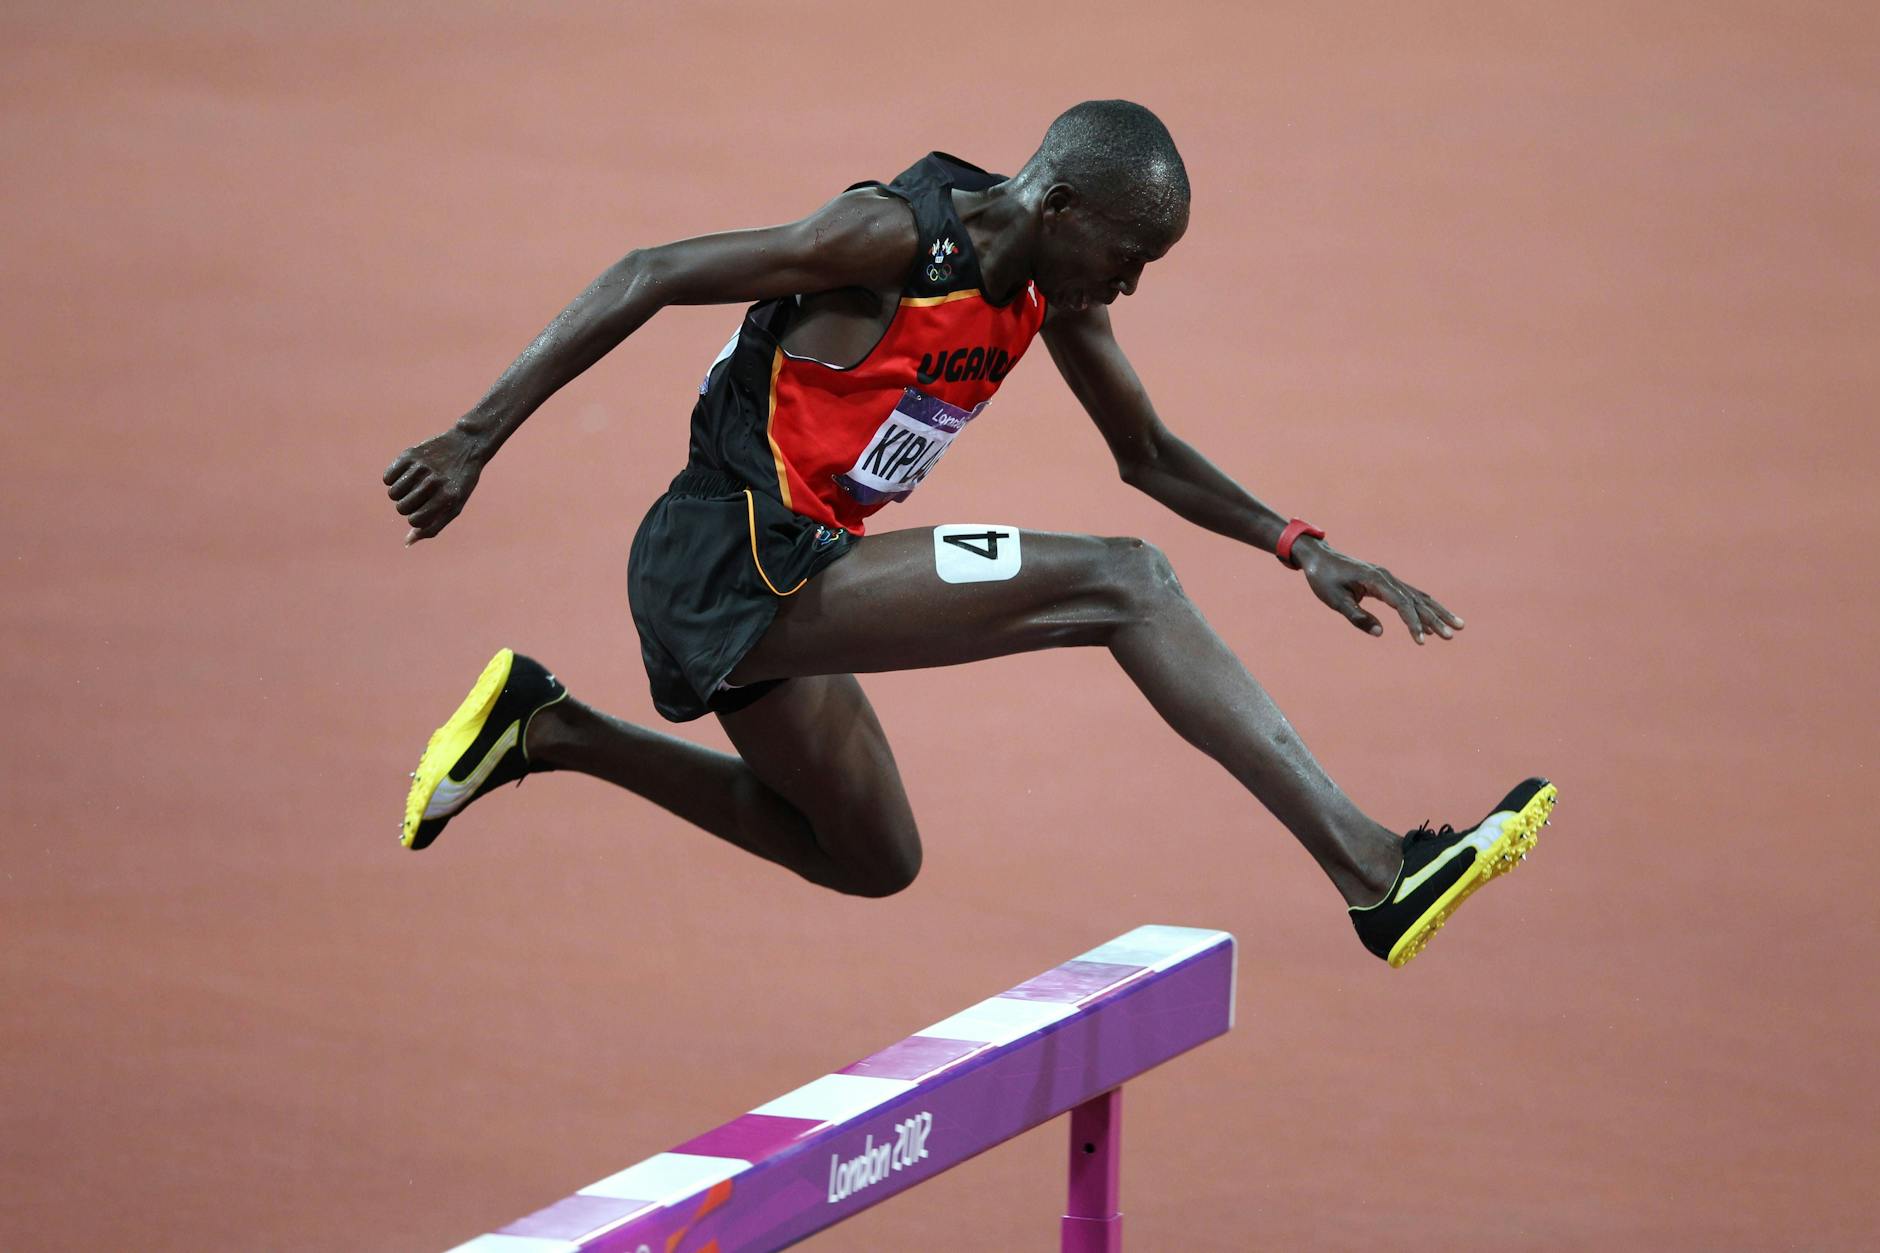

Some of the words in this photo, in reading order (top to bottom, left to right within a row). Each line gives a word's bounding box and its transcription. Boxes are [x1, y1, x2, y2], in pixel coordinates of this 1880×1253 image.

[932, 408, 966, 429] Lond
[943, 531, 1010, 560] 4
[827, 1134, 892, 1203] London
[891, 1111, 933, 1171] 2012
